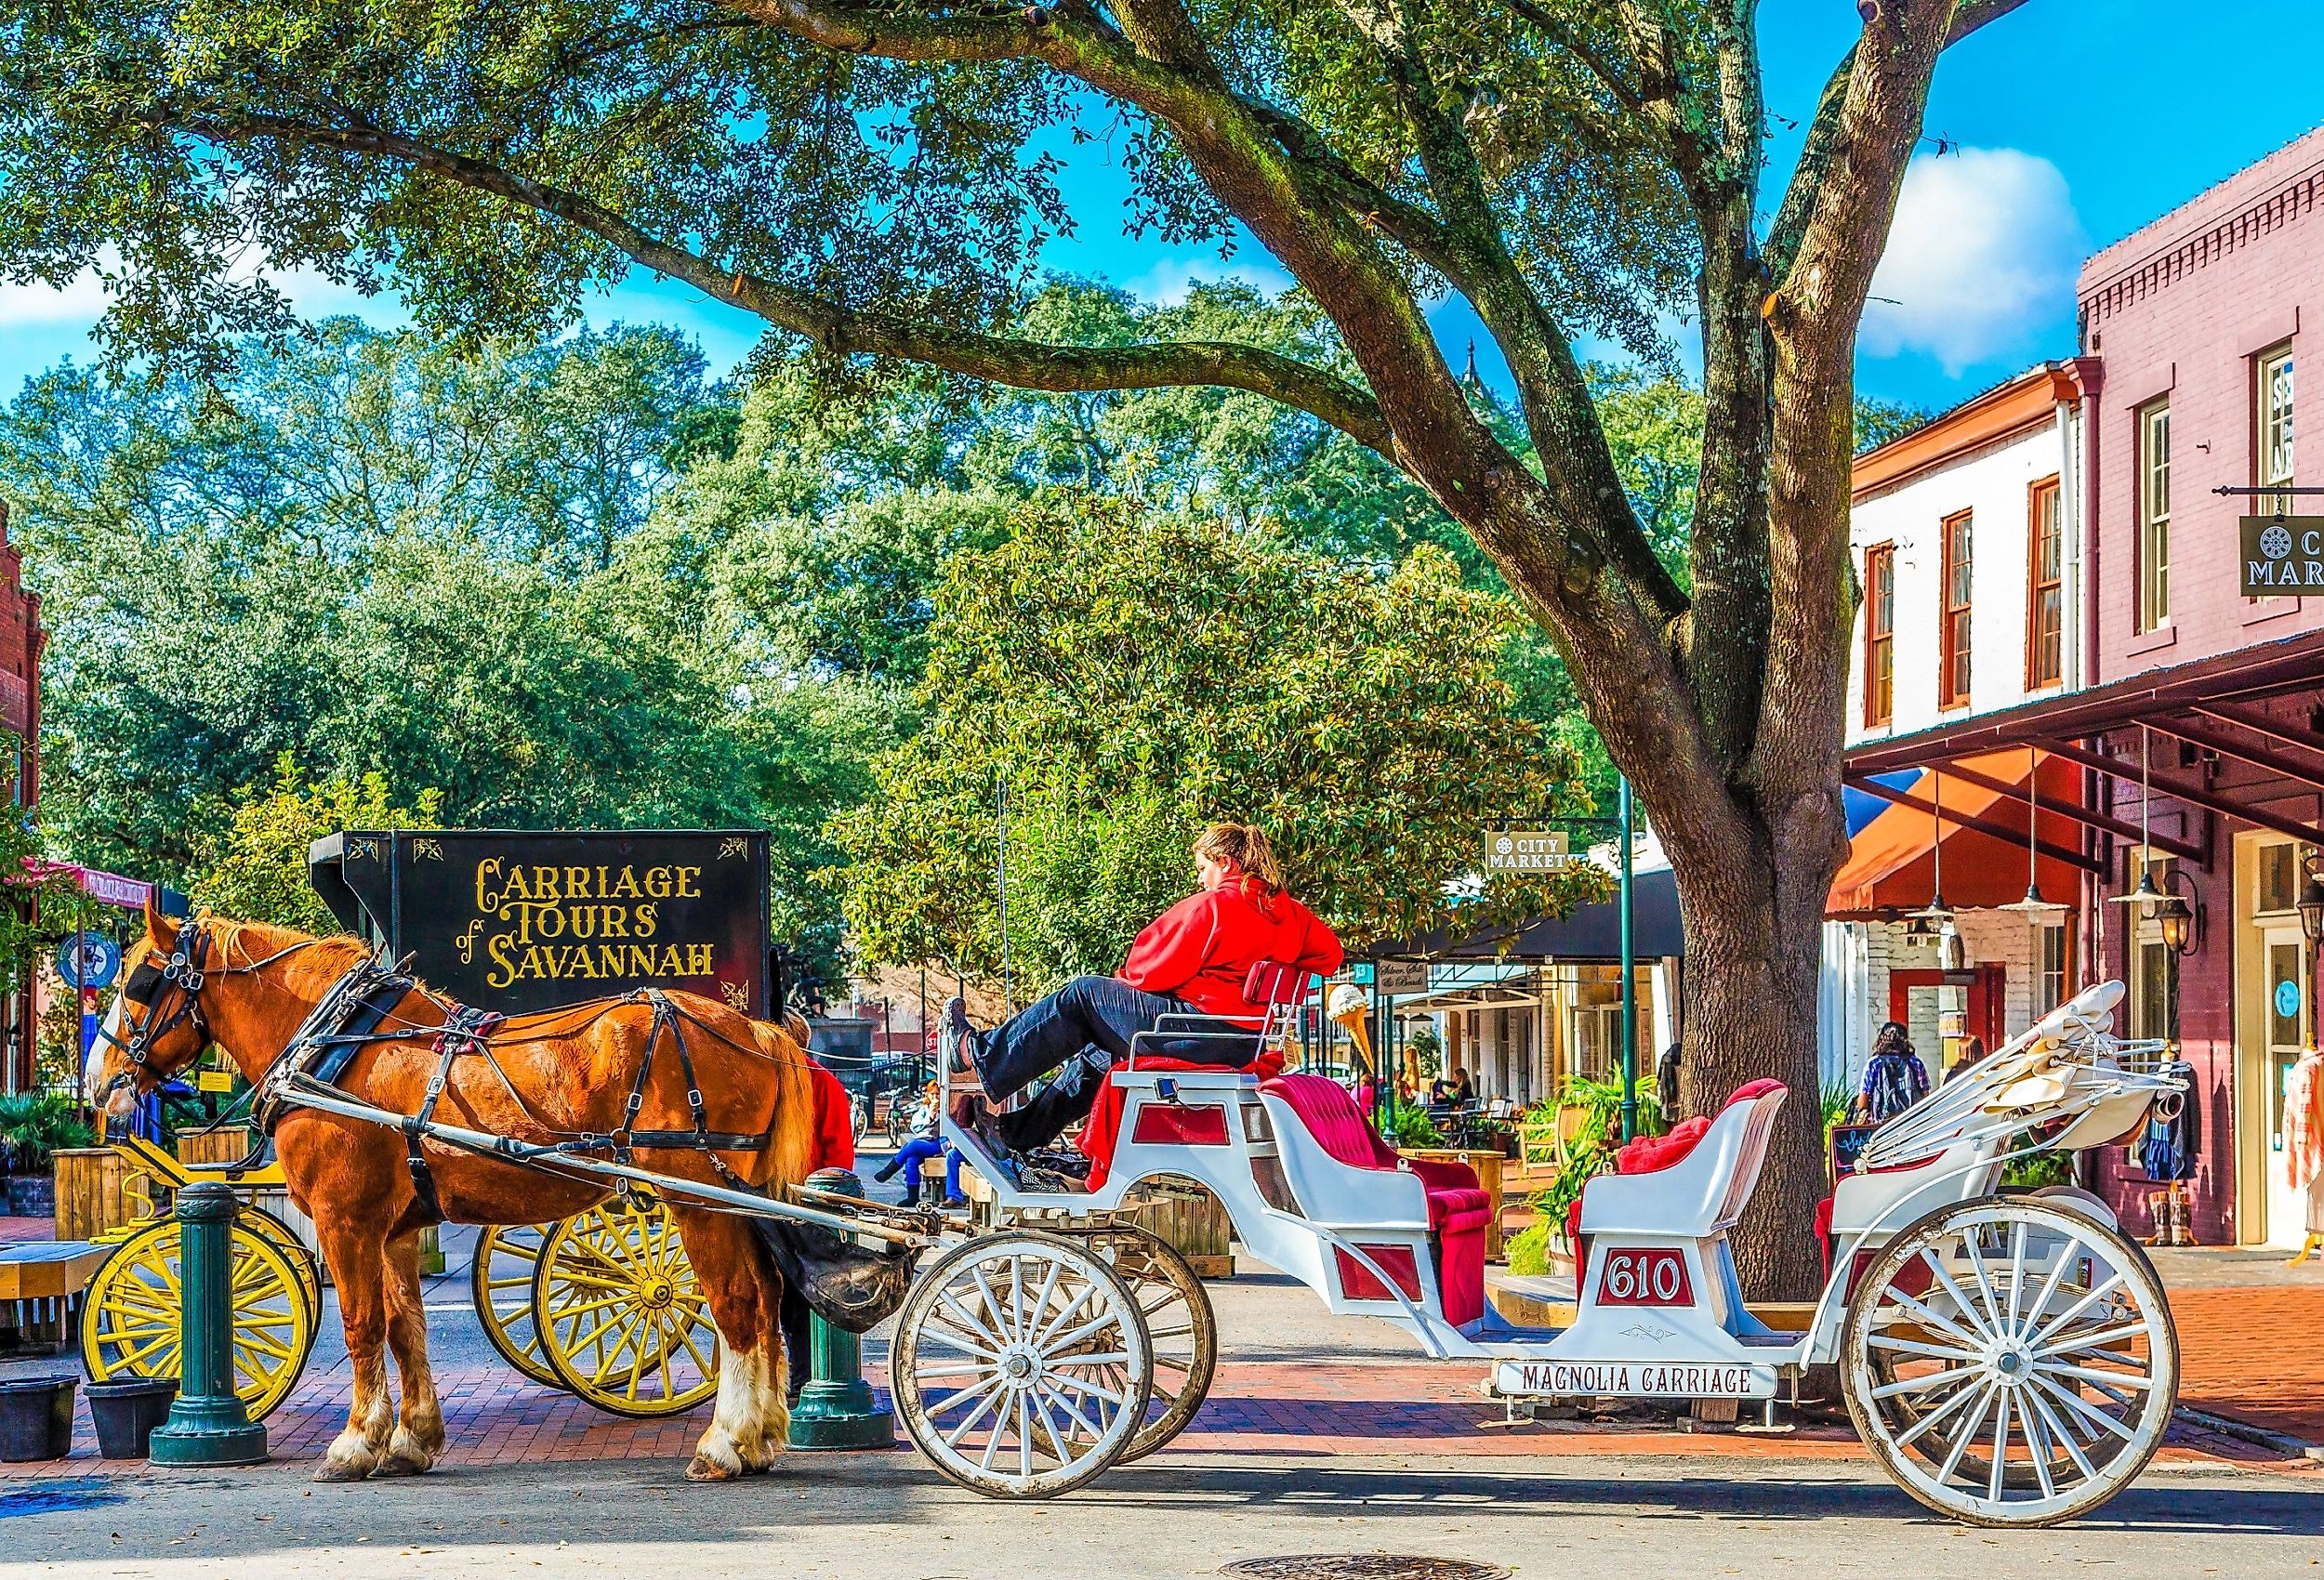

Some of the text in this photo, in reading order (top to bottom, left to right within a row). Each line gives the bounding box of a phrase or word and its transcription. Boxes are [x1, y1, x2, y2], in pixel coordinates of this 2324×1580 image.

[1489, 854, 1565, 868] MARKET
[1516, 839, 1559, 853] CITY
[475, 856, 702, 913] CARRIAGE
[499, 899, 659, 944] TOURS
[456, 918, 715, 988] of SAVANNAH
[1607, 1256, 1681, 1301] 610
[1522, 1365, 1752, 1393] MAGNOLIA CARRIAGE
